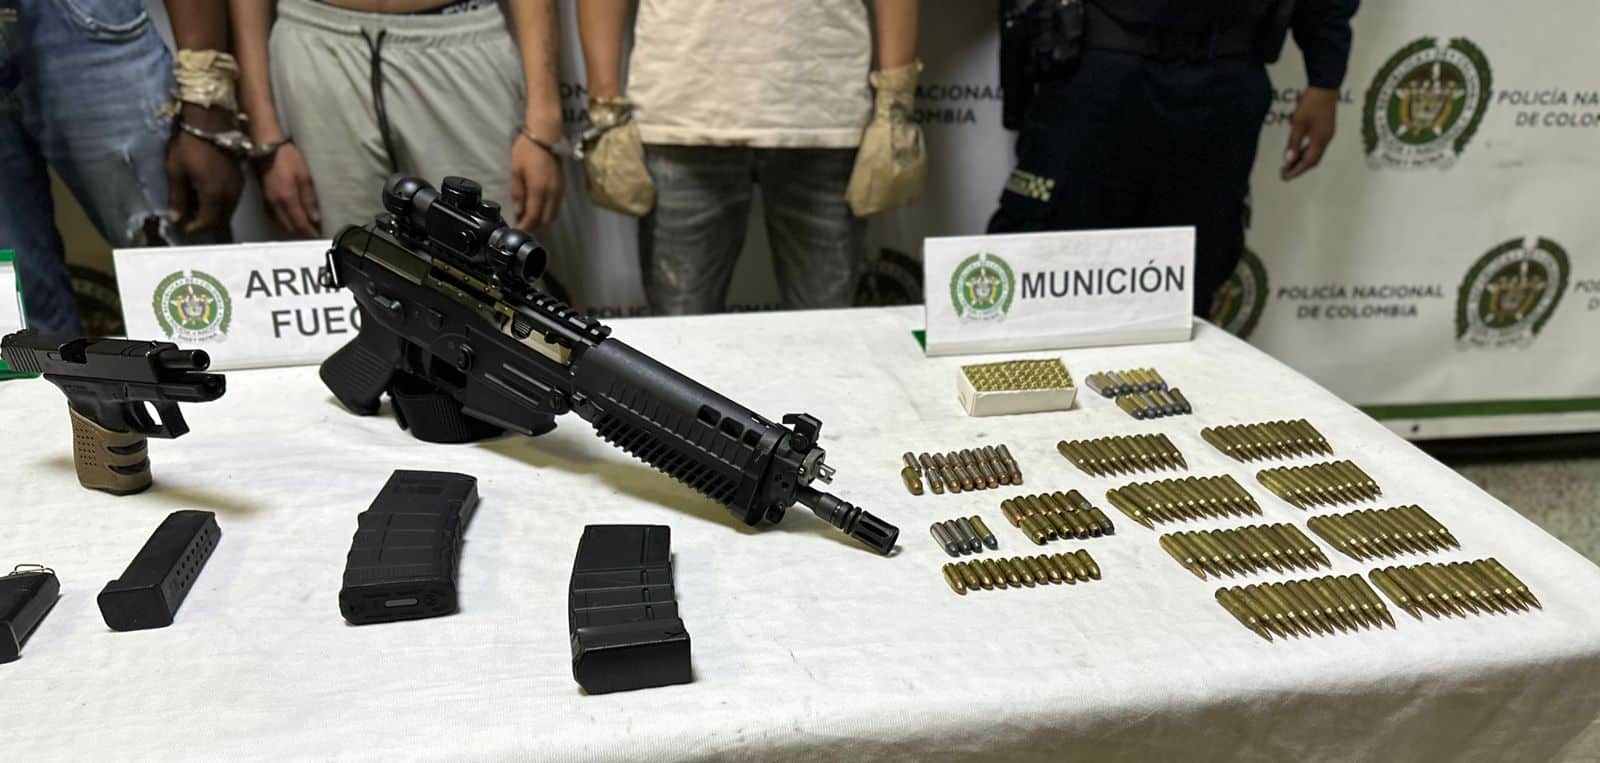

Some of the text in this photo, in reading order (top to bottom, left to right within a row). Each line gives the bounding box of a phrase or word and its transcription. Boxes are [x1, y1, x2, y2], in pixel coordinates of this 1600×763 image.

[915, 84, 1003, 100] ACIONAL
[1497, 85, 1567, 105] POLICÍA
[1515, 112, 1600, 128] DE COLO
[245, 266, 340, 298] ARM
[1021, 259, 1185, 299] MUNICIÓN
[1352, 284, 1444, 299] NACIONAL
[1296, 303, 1418, 320] DE COLOMBIA
